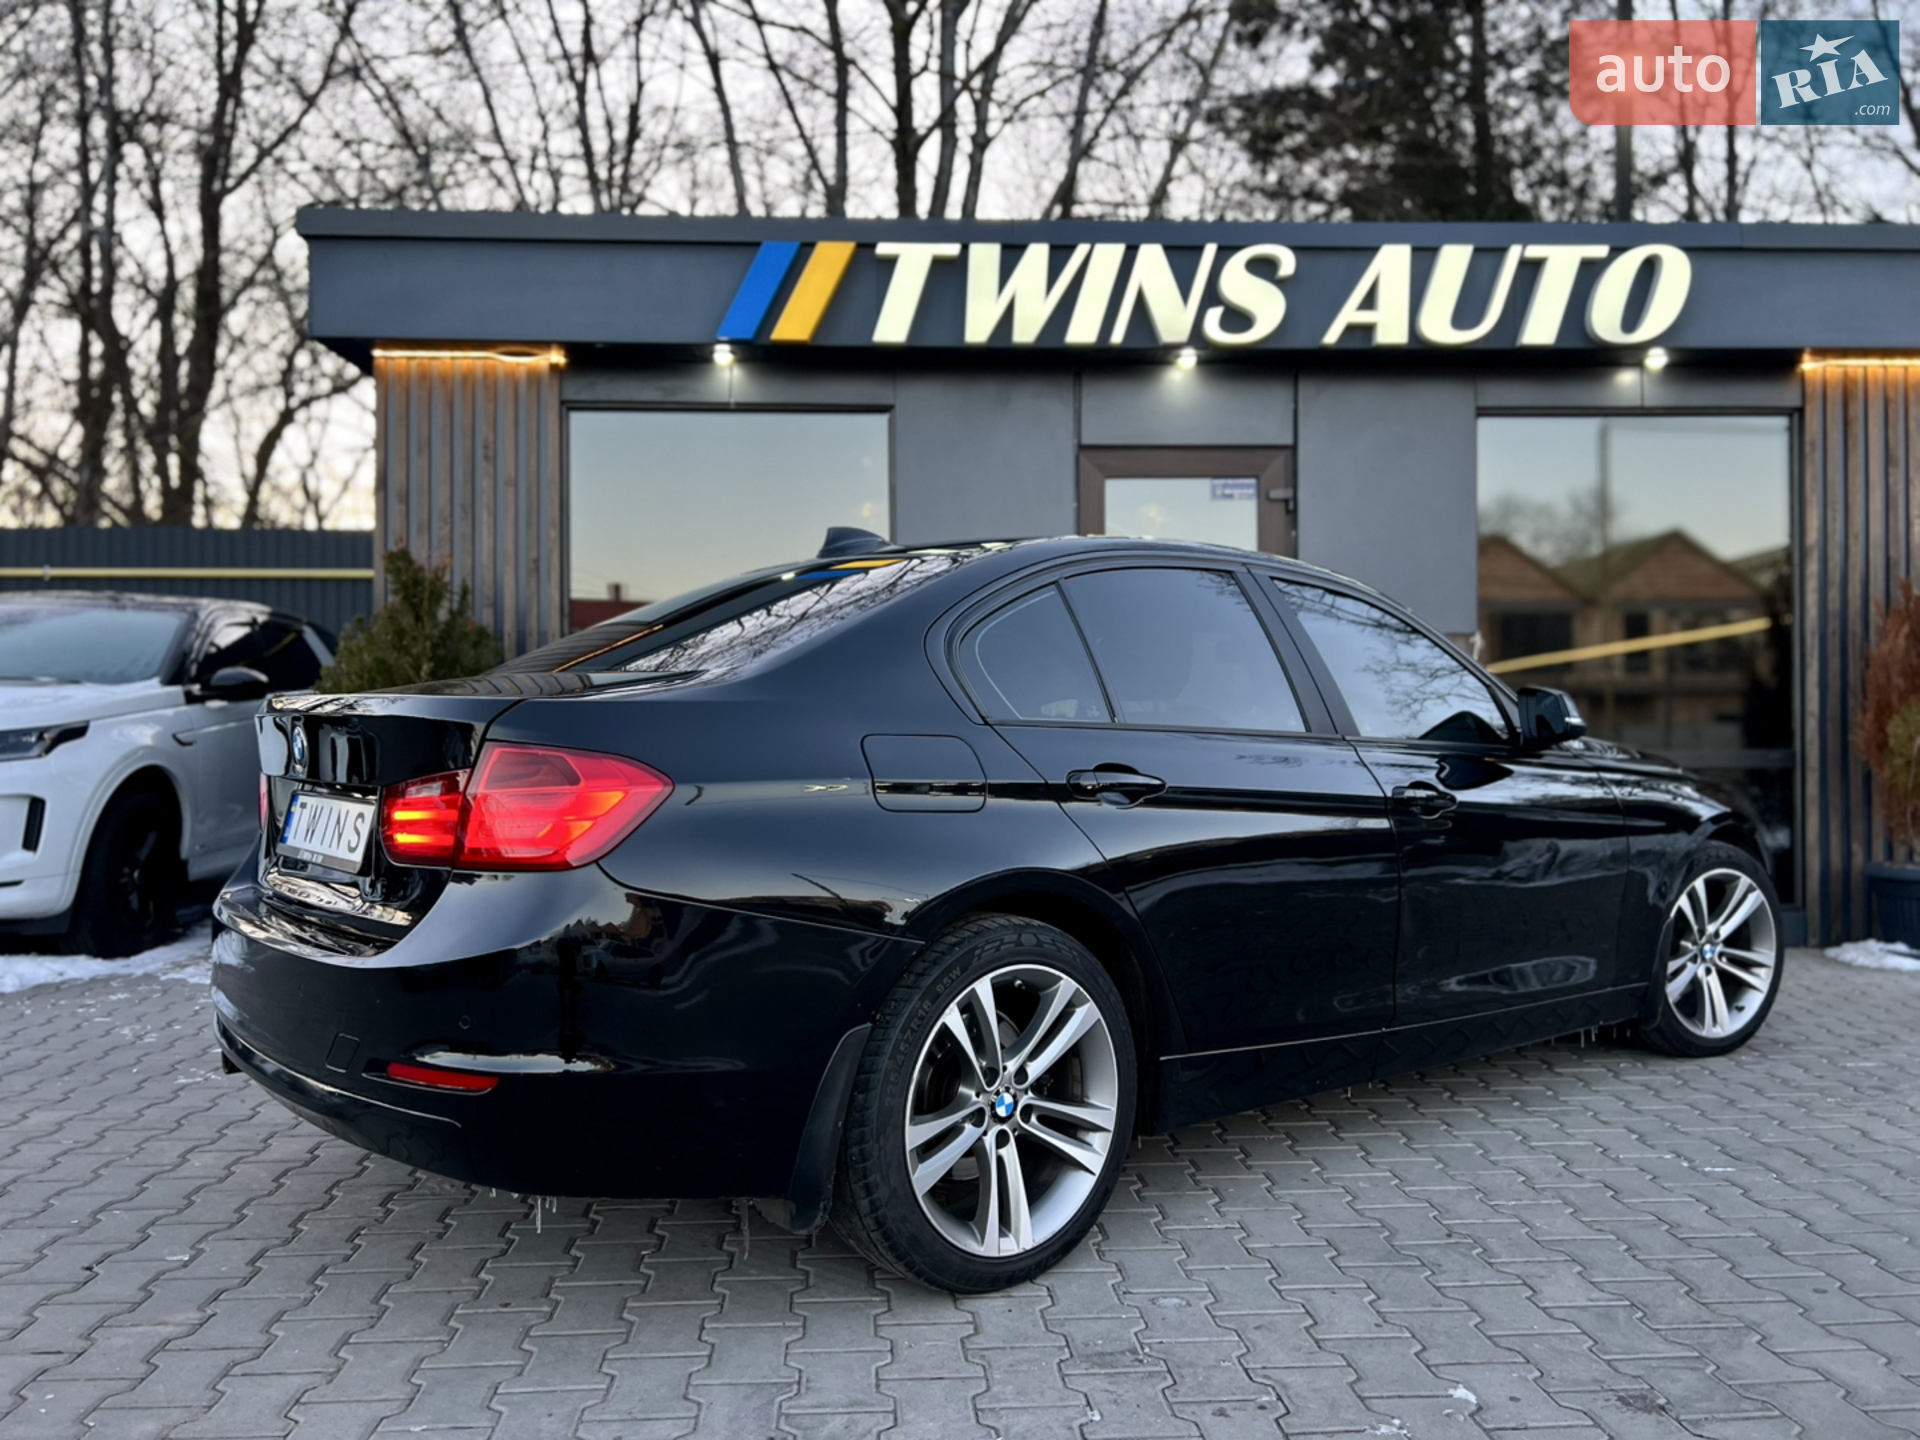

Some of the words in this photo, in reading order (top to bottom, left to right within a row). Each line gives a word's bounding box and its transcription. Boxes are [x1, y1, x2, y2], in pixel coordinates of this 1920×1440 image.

[871, 242, 1297, 346] TWINS
[1320, 243, 1692, 346] AUTO
[293, 801, 366, 854] TWINS
[935, 965, 961, 995] 95W
